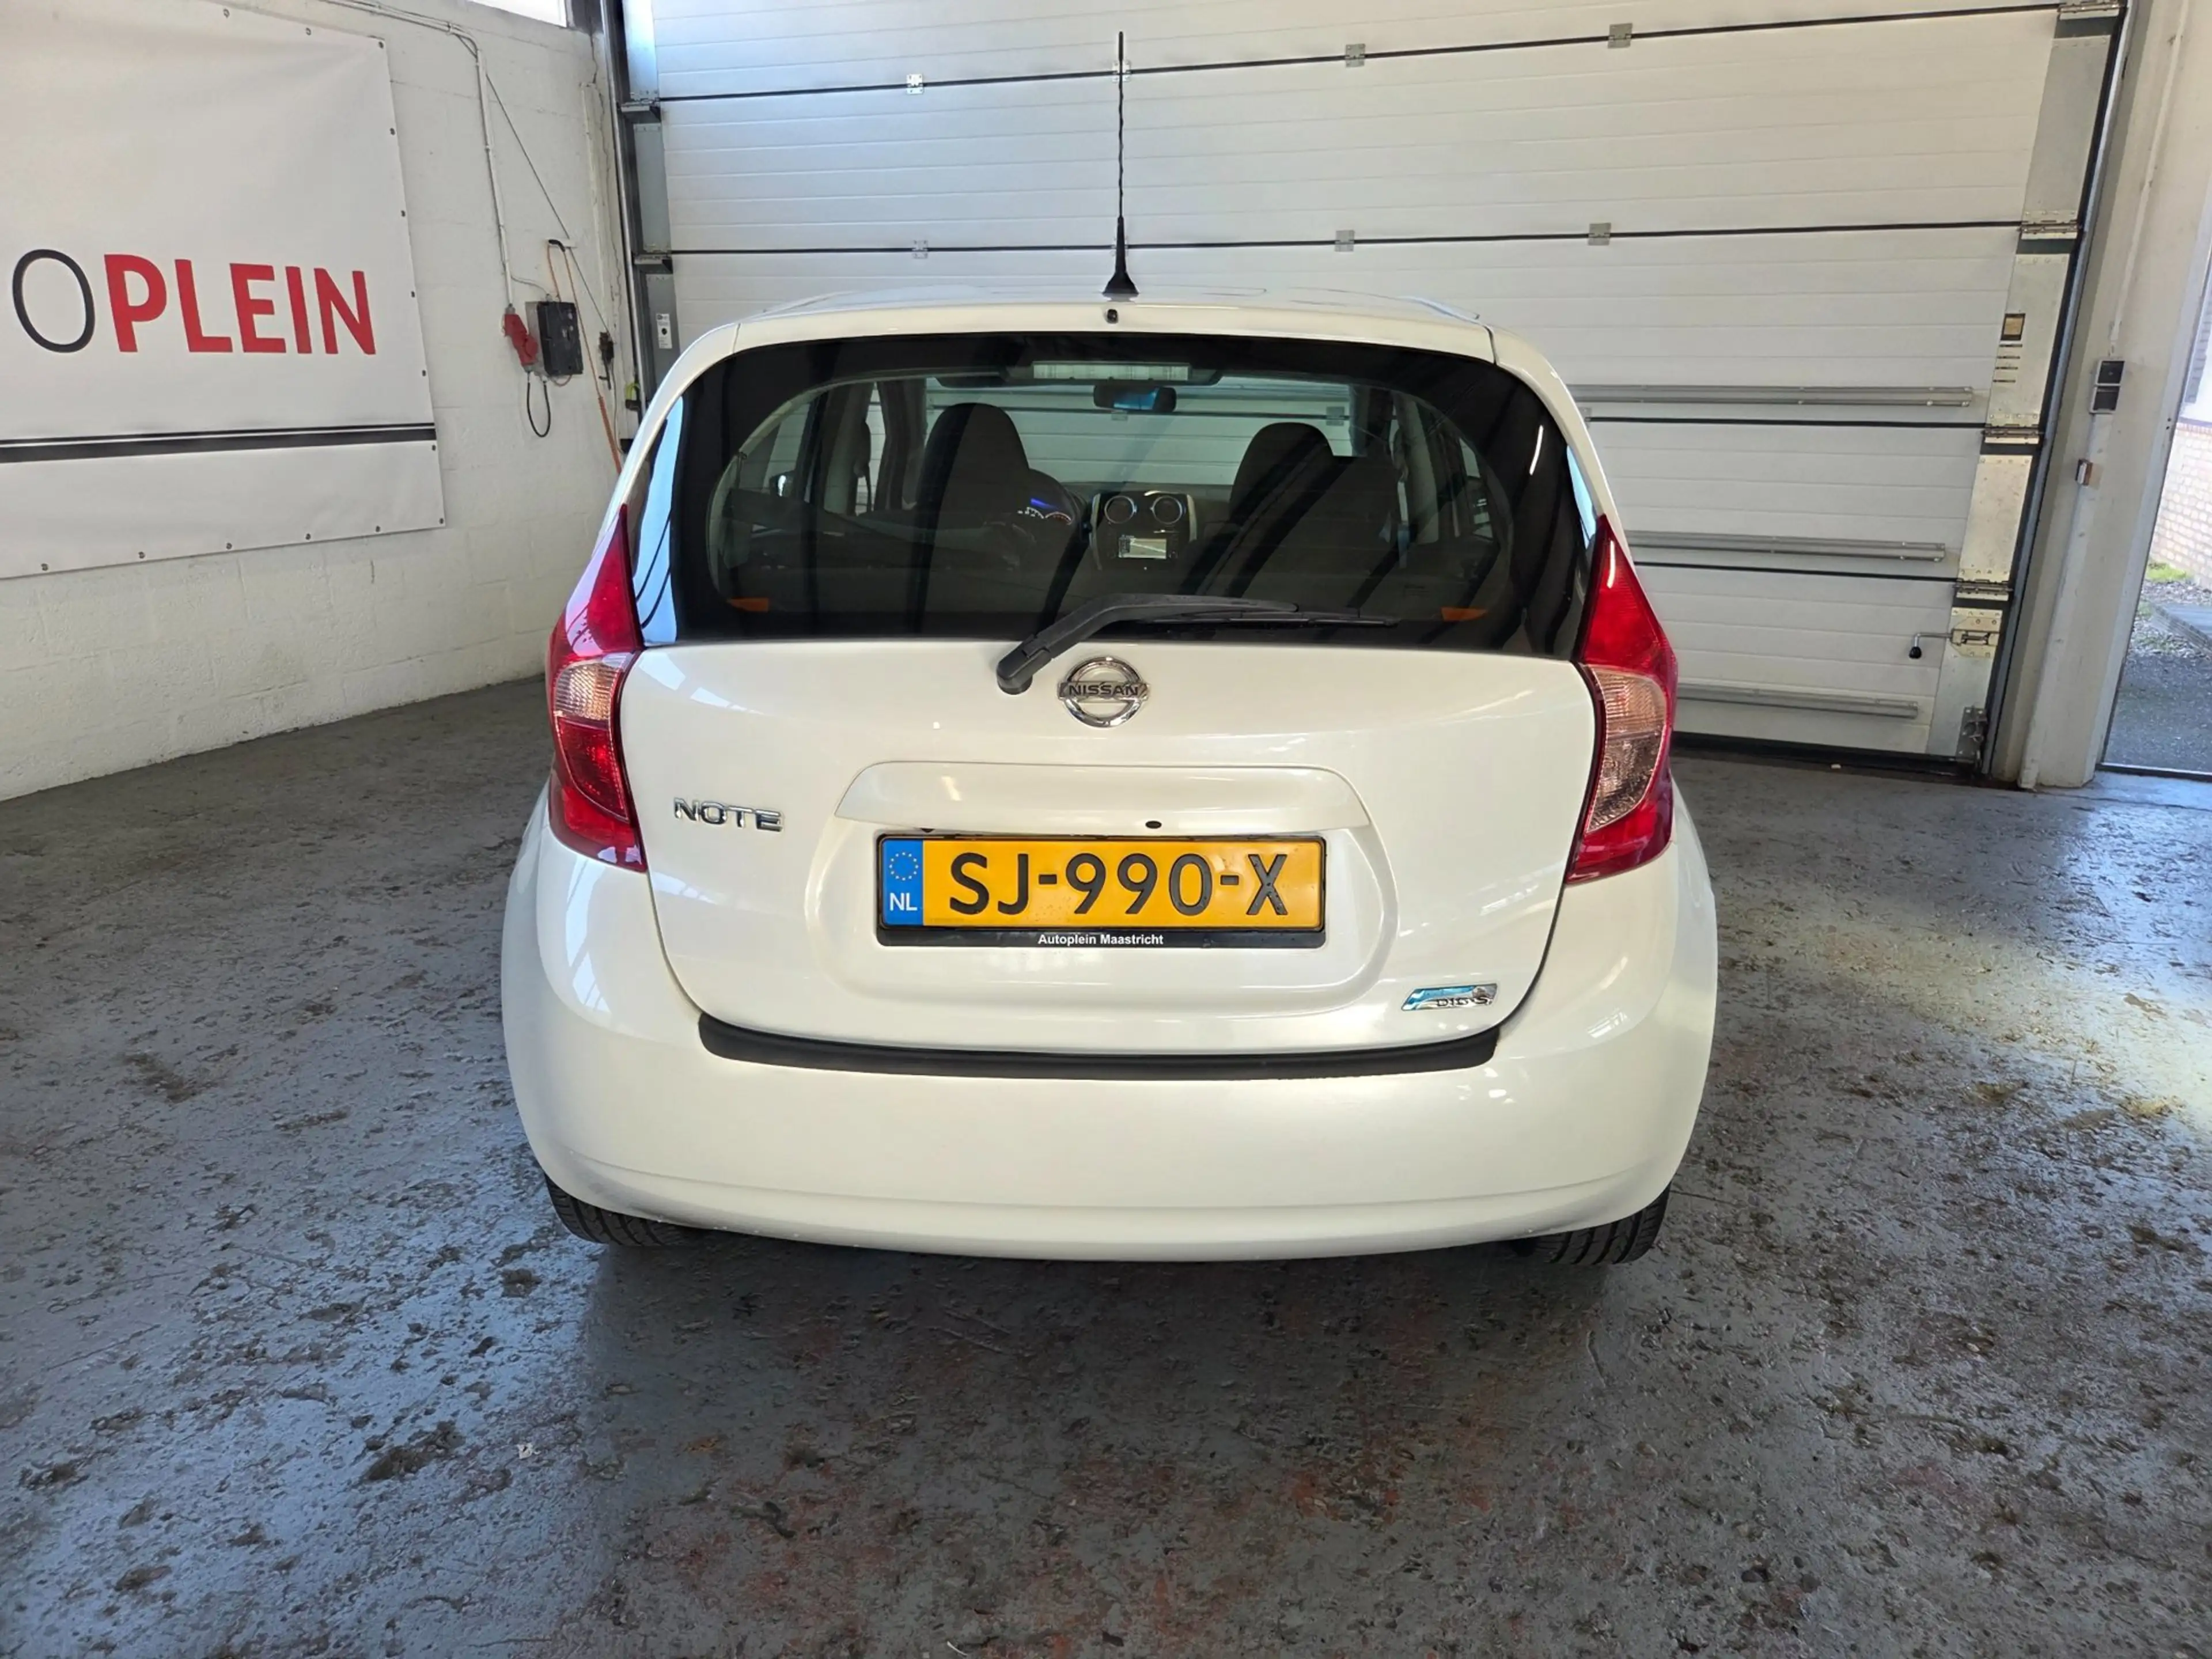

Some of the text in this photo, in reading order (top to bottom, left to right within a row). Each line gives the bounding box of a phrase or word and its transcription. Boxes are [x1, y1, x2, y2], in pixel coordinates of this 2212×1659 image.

[1069, 684, 1138, 696] NISSAN
[674, 797, 782, 832] NOTE
[949, 852, 1288, 916] SJ-990-X
[889, 892, 918, 911] NL
[1038, 934, 1164, 946] Autoplein Maastricht
